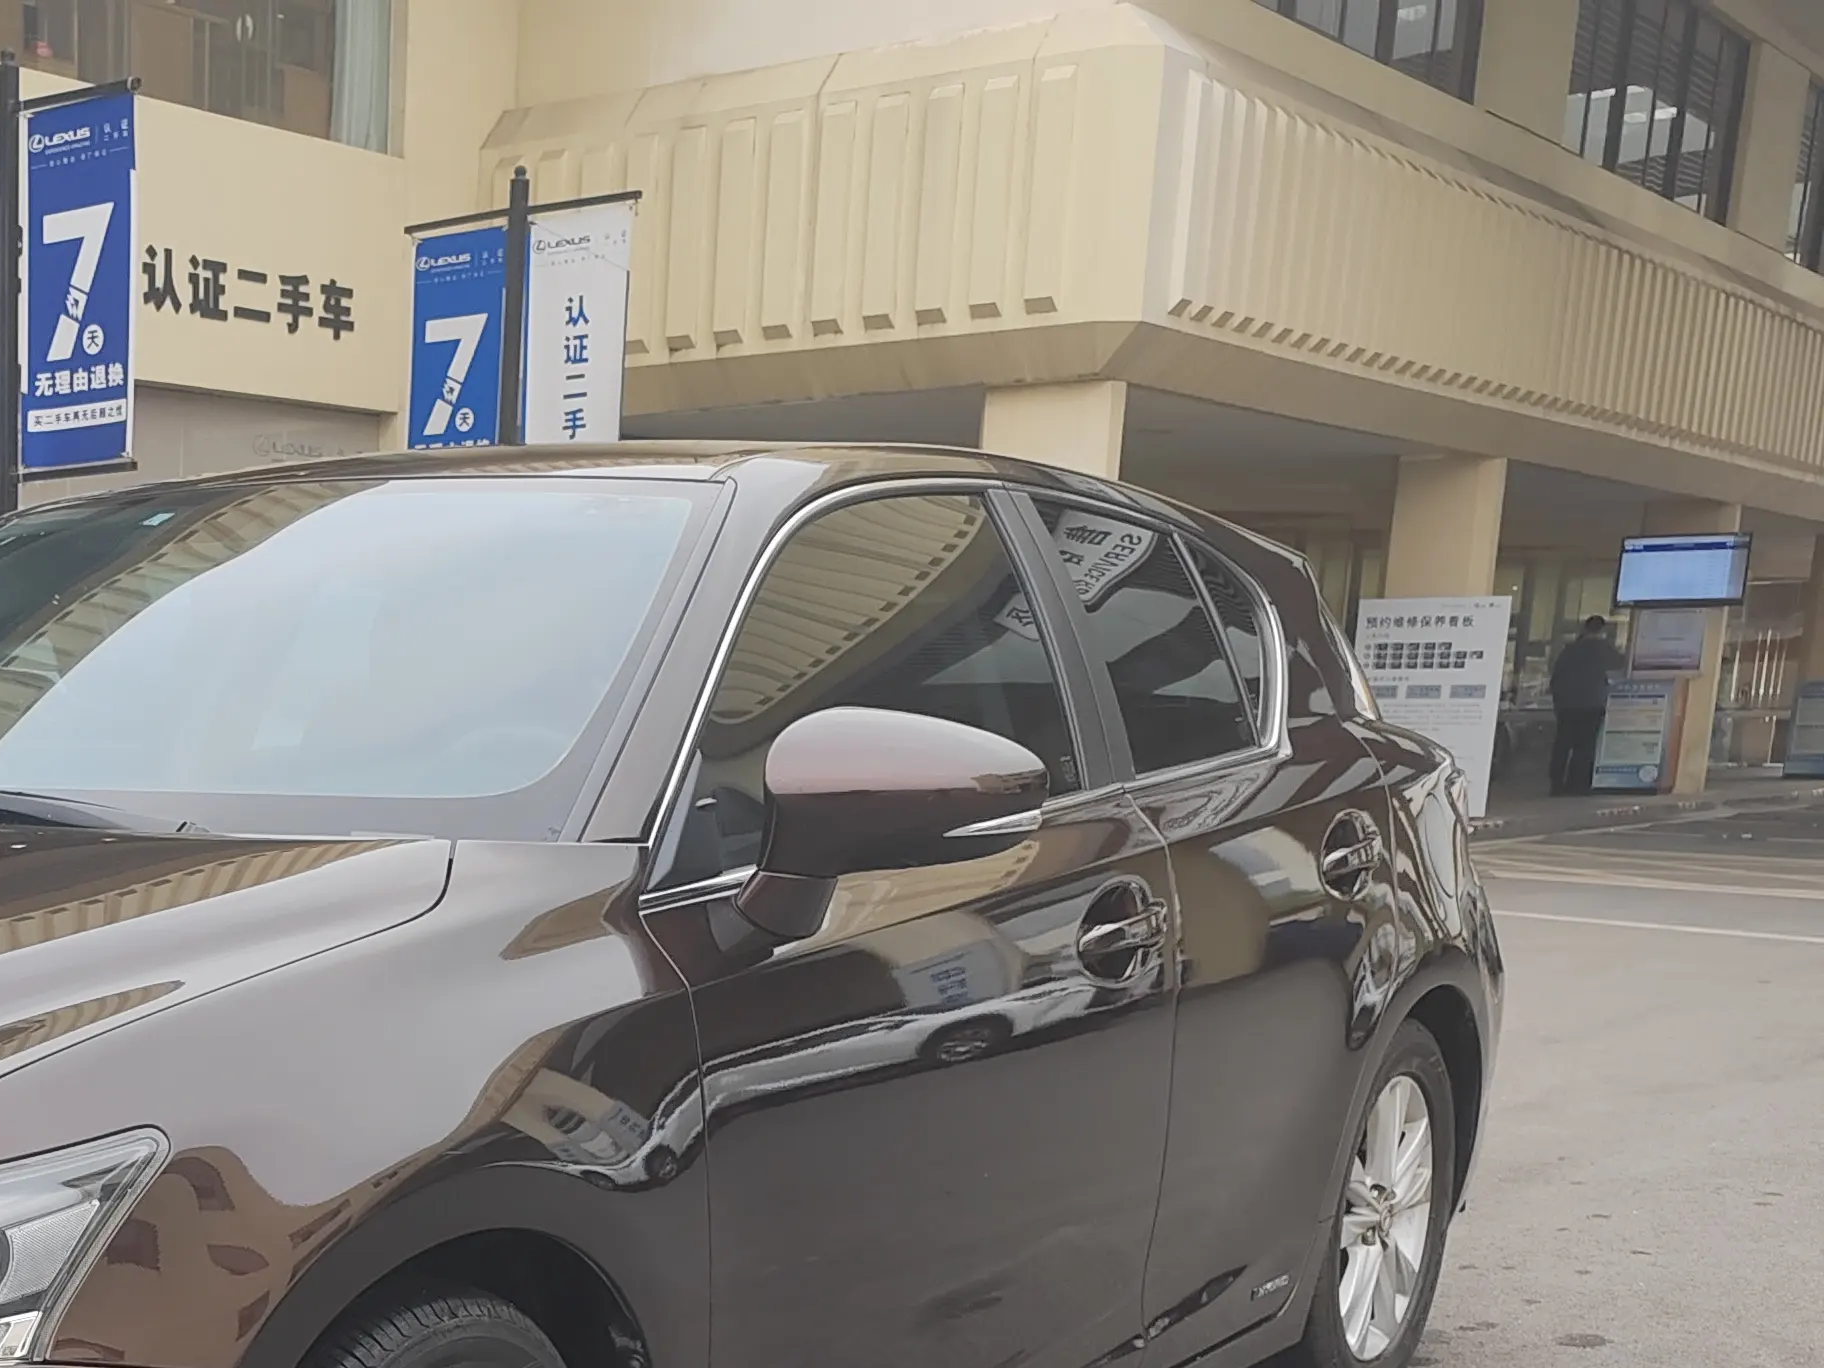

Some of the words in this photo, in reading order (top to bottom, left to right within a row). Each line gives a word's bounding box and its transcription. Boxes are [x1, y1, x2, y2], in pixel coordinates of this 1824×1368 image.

[45, 127, 91, 146] LEXUS
[431, 253, 472, 266] LEXUS
[547, 235, 591, 249] LEXUS
[43, 201, 115, 362] 7
[142, 244, 355, 341] 认证二手车
[35, 361, 124, 397] 无理由退换
[423, 313, 489, 436] 7
[562, 295, 590, 440] 认证二手
